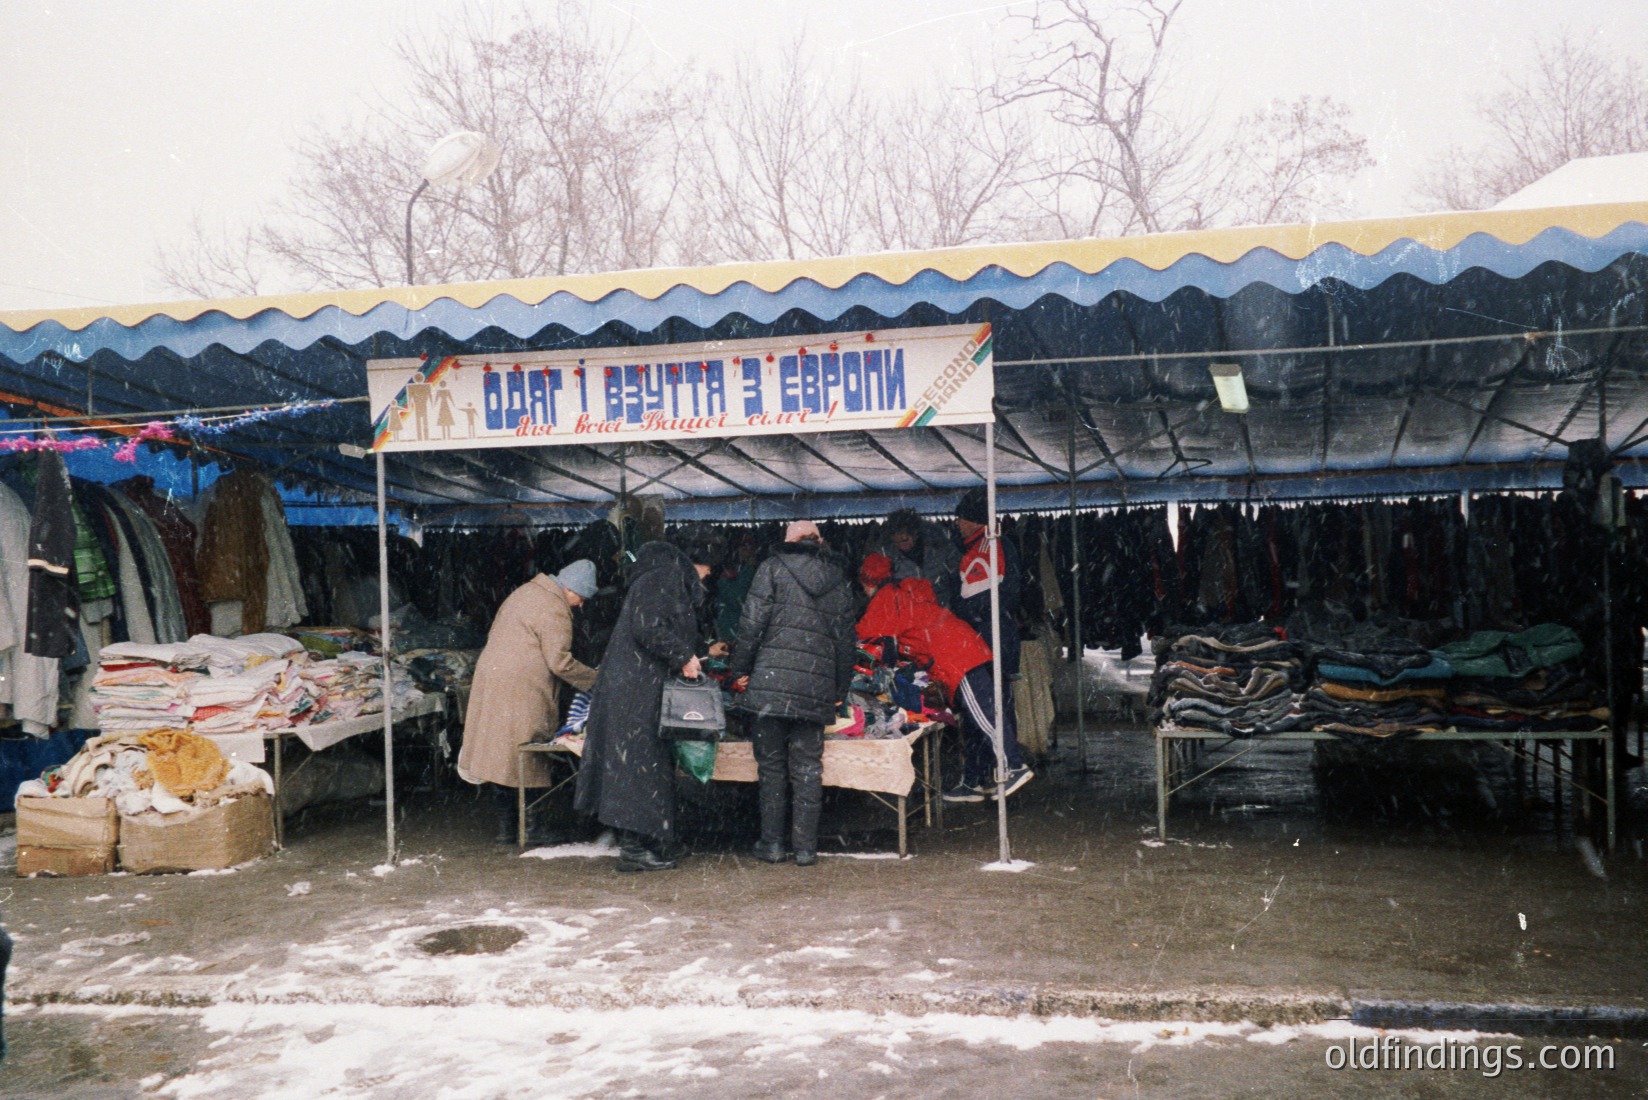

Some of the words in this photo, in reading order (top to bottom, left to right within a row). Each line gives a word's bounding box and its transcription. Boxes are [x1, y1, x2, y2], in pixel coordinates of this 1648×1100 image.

[483, 368, 563, 430] ОДЯГ
[604, 360, 727, 424] ВЗУТТЯ
[741, 357, 764, 418] З
[913, 339, 978, 413] SECOND
[931, 361, 978, 411] HAND
